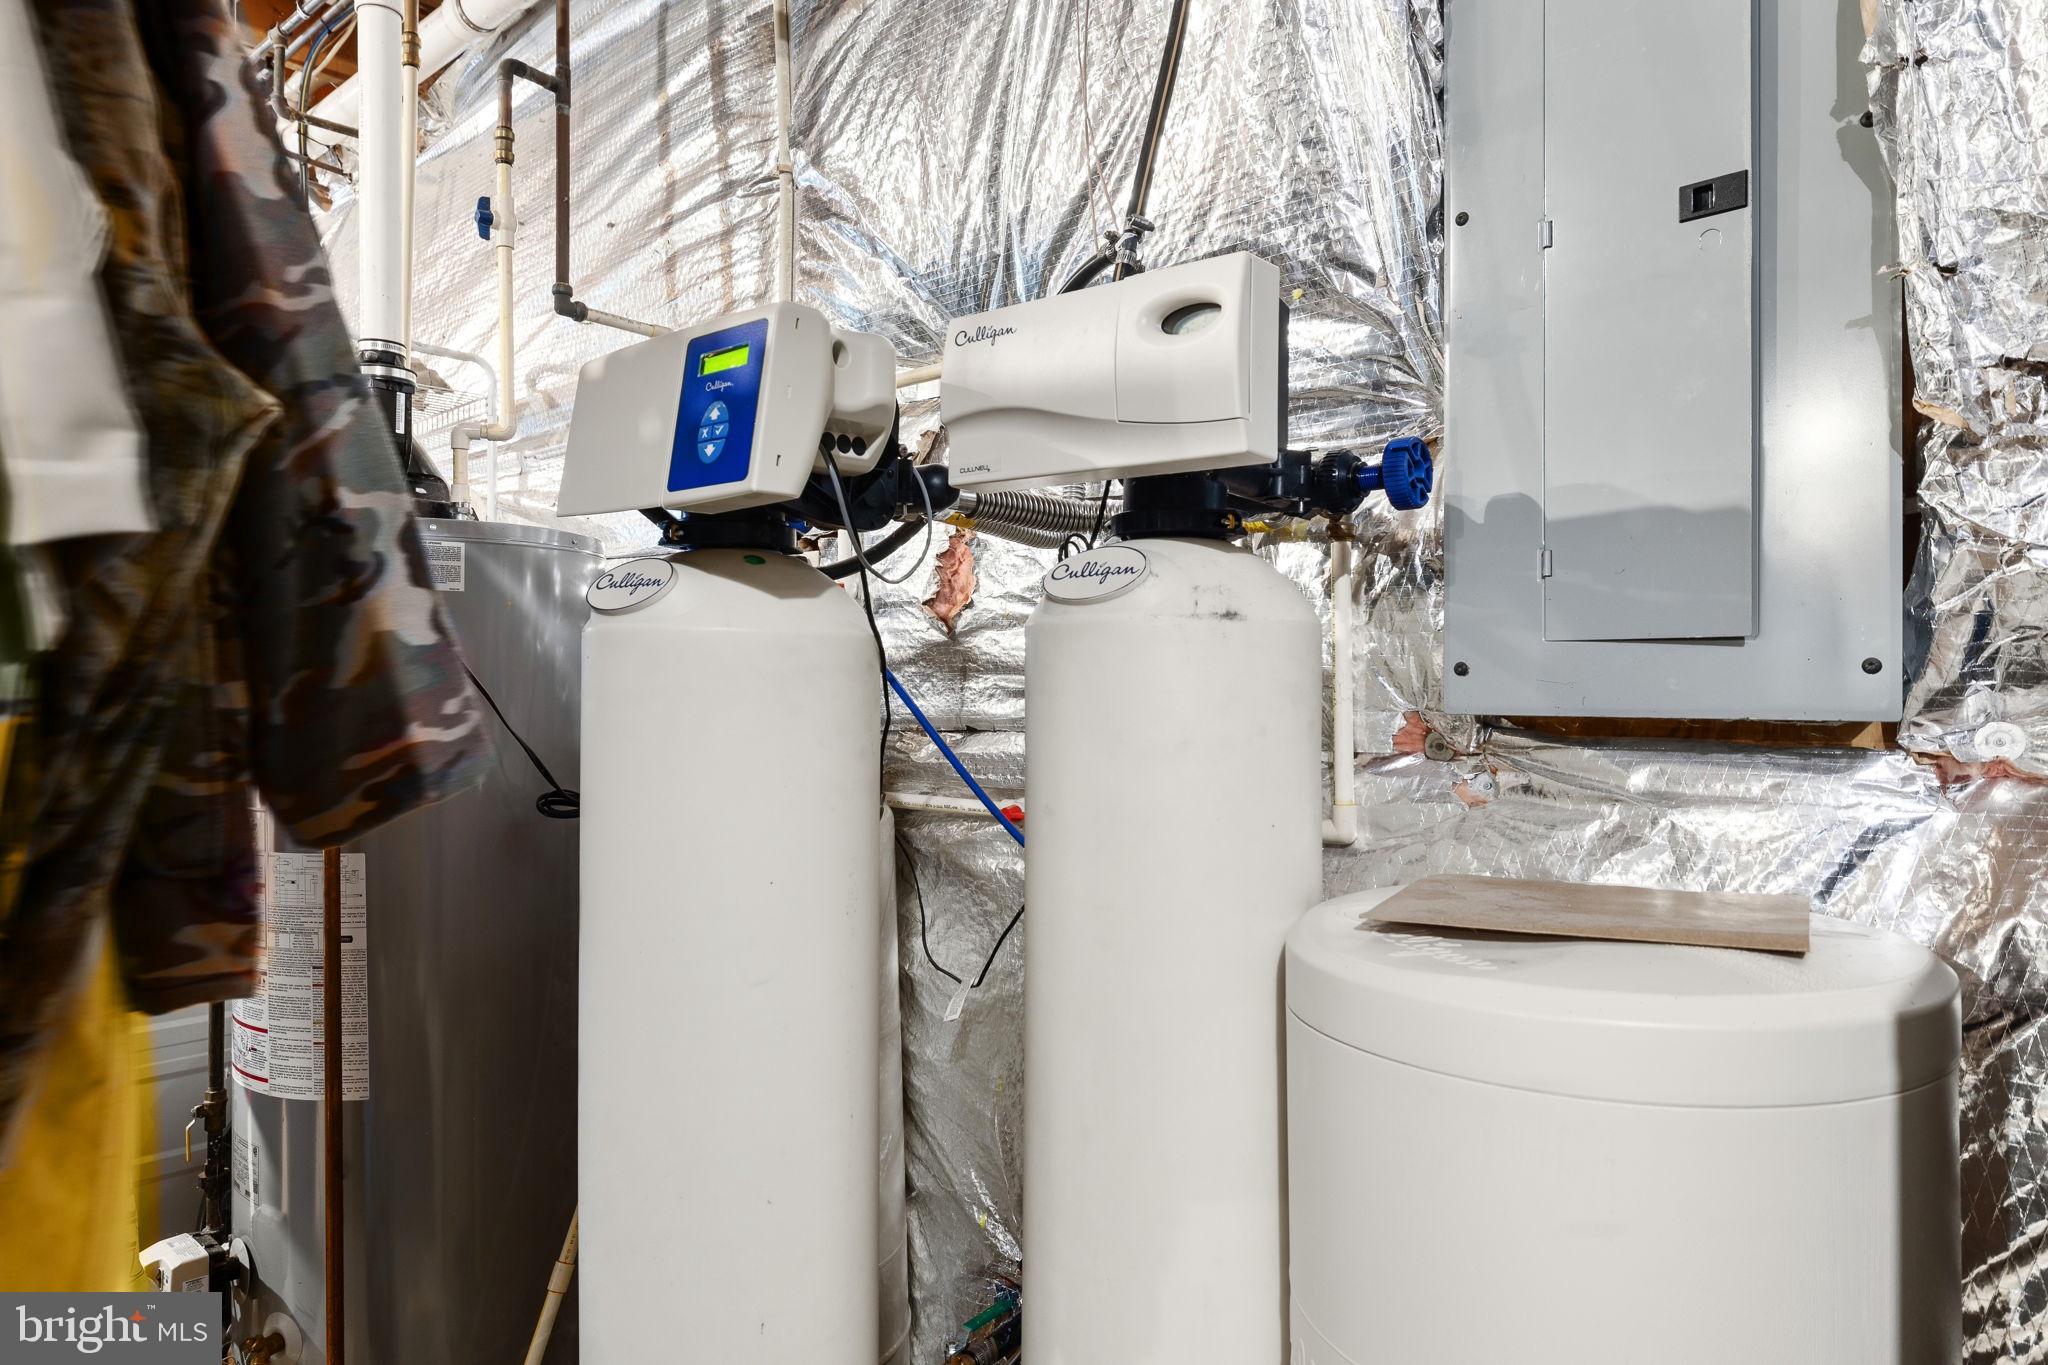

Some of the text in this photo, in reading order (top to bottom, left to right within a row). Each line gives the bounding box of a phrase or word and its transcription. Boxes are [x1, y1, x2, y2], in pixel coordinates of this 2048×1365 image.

[954, 325, 1017, 347] Culligan
[705, 380, 734, 392] Culligan
[596, 572, 665, 596] Culligan
[1051, 561, 1140, 585] Culligan
